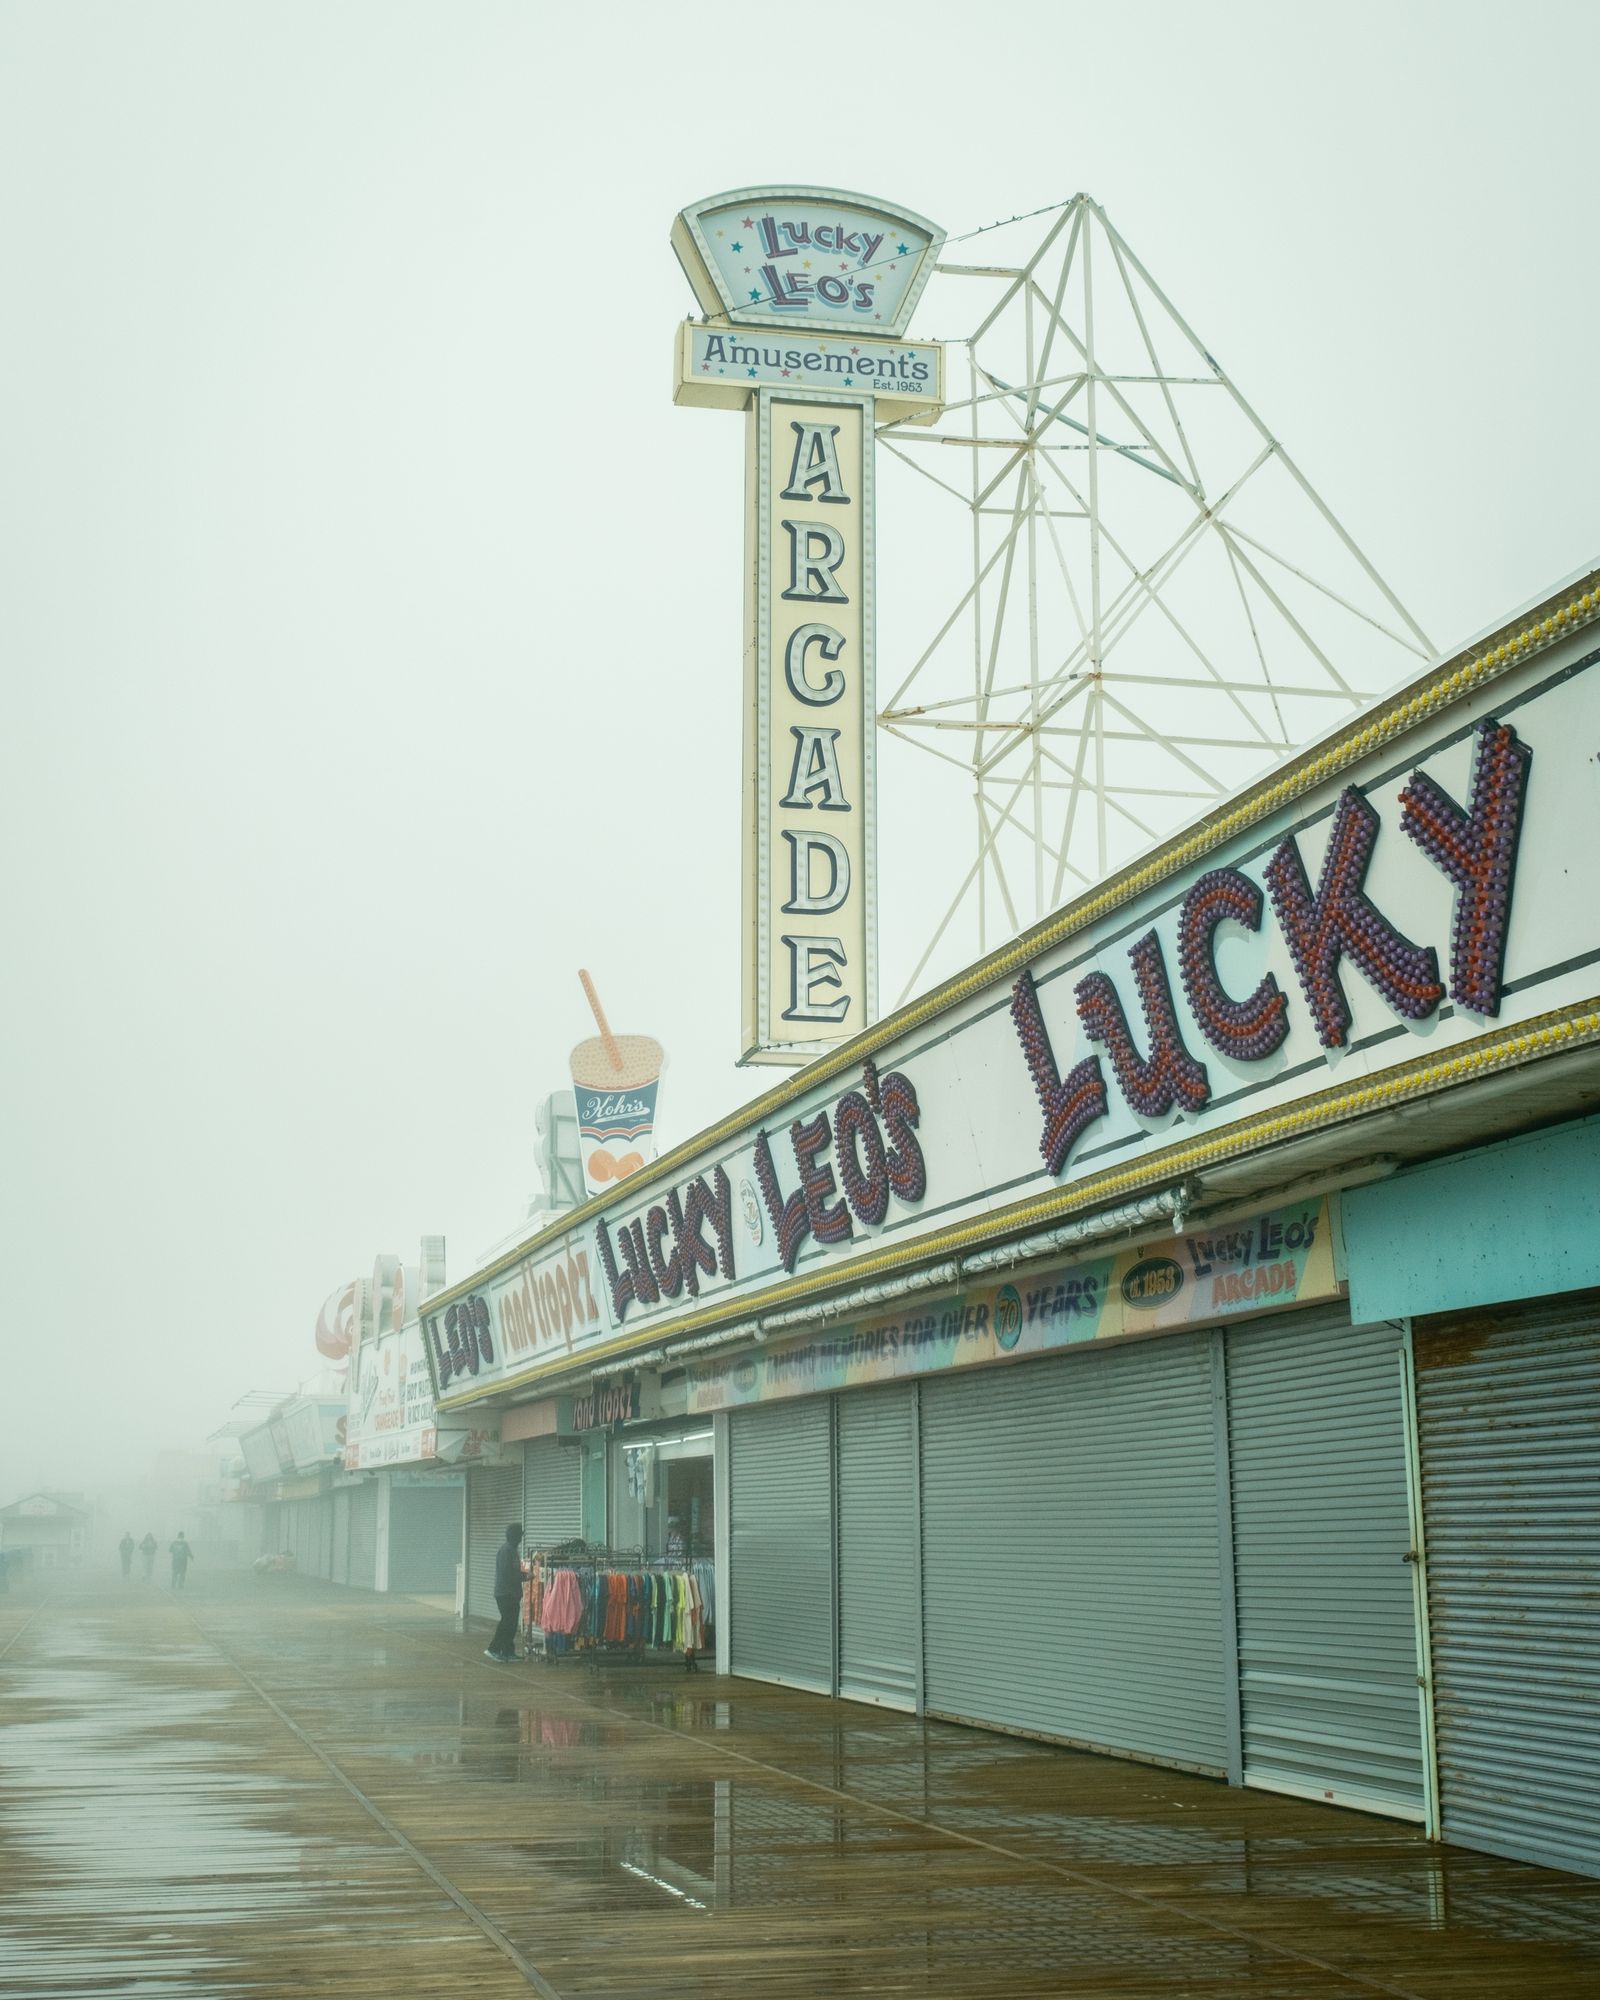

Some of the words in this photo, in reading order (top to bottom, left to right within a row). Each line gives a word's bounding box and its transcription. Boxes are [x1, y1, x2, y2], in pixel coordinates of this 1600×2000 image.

[703, 334, 930, 381] Amusements
[872, 378, 895, 391] Est.
[896, 380, 924, 393] 1953
[780, 420, 852, 1023] ARCADE
[1009, 717, 1534, 1177] LUCKY
[582, 1093, 645, 1120] Kohr's
[596, 1164, 736, 1324] LUCKY
[753, 1057, 927, 1274] LEO'S
[1143, 1266, 1176, 1297] 1953
[1211, 1259, 1297, 1309] ARCADE
[903, 1315, 938, 1358] FOR
[941, 1303, 992, 1349] OVER
